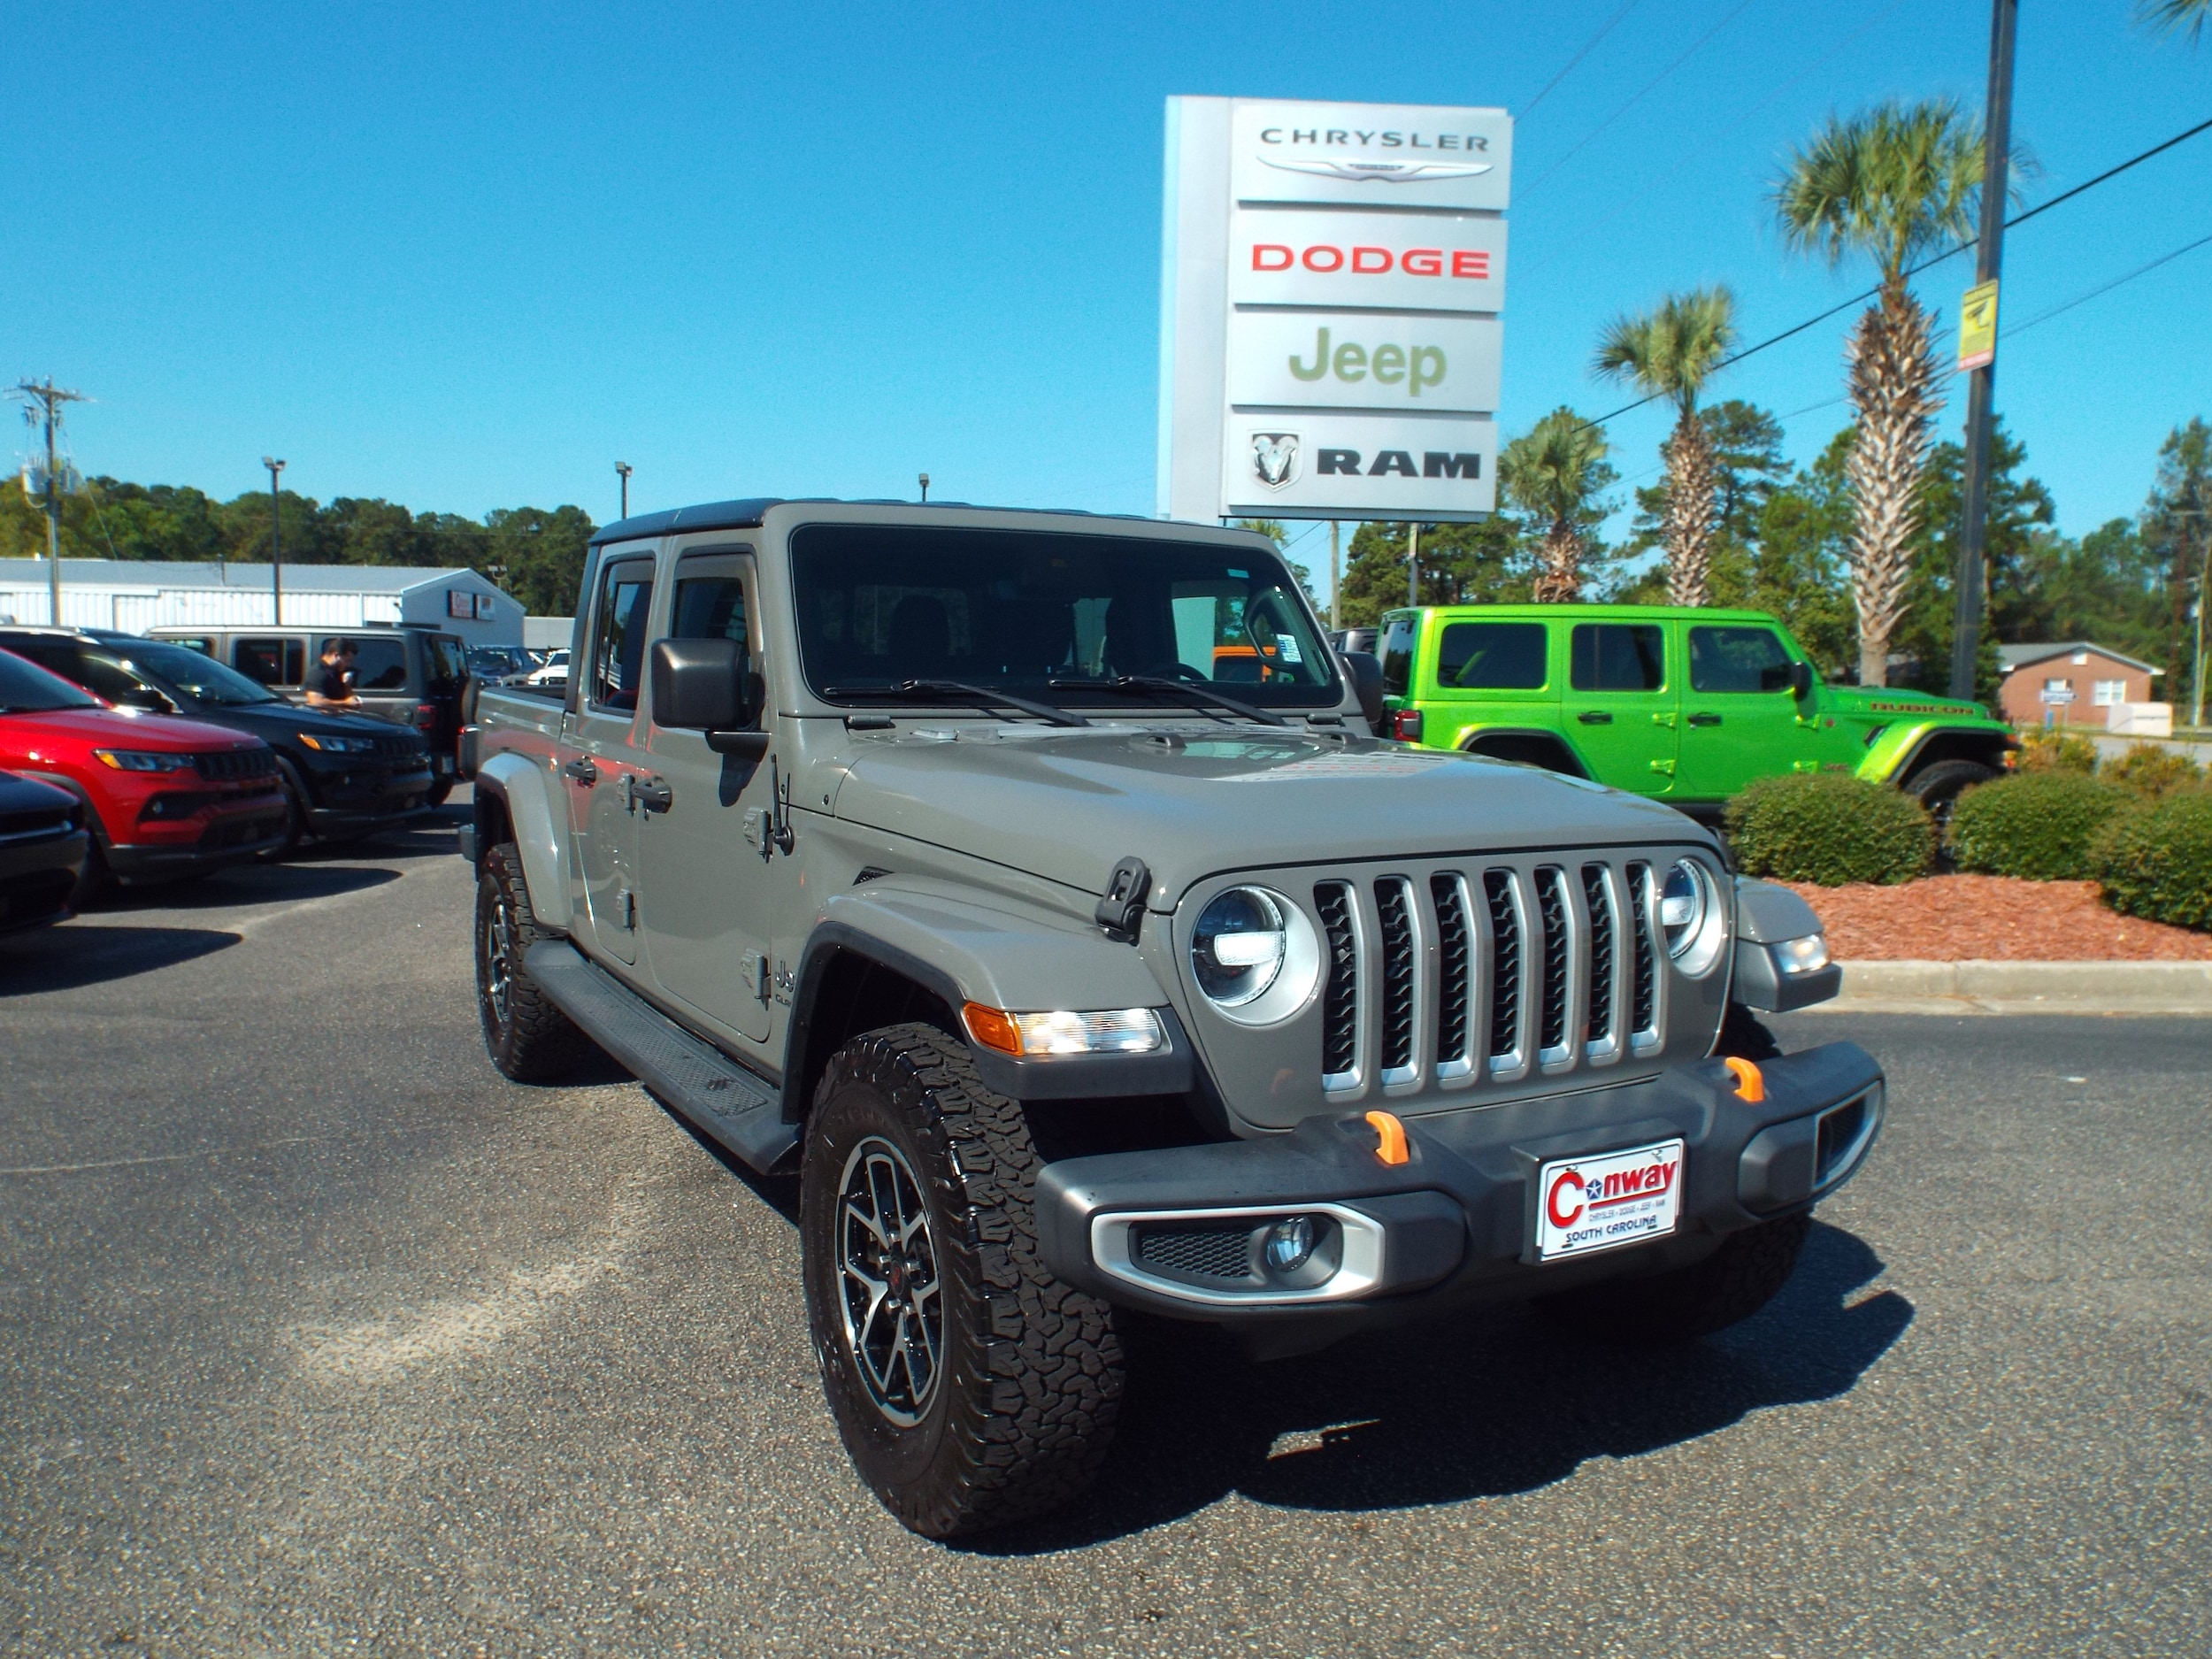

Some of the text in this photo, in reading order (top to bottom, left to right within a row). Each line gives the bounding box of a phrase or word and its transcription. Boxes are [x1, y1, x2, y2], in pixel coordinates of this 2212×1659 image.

[1260, 127, 1490, 152] CHRYSLER
[1251, 243, 1490, 280] DODGE
[1288, 326, 1448, 397] Jeep
[1317, 447, 1481, 480] RAM
[1565, 1214, 1657, 1243] SOUTH CAROLINA
